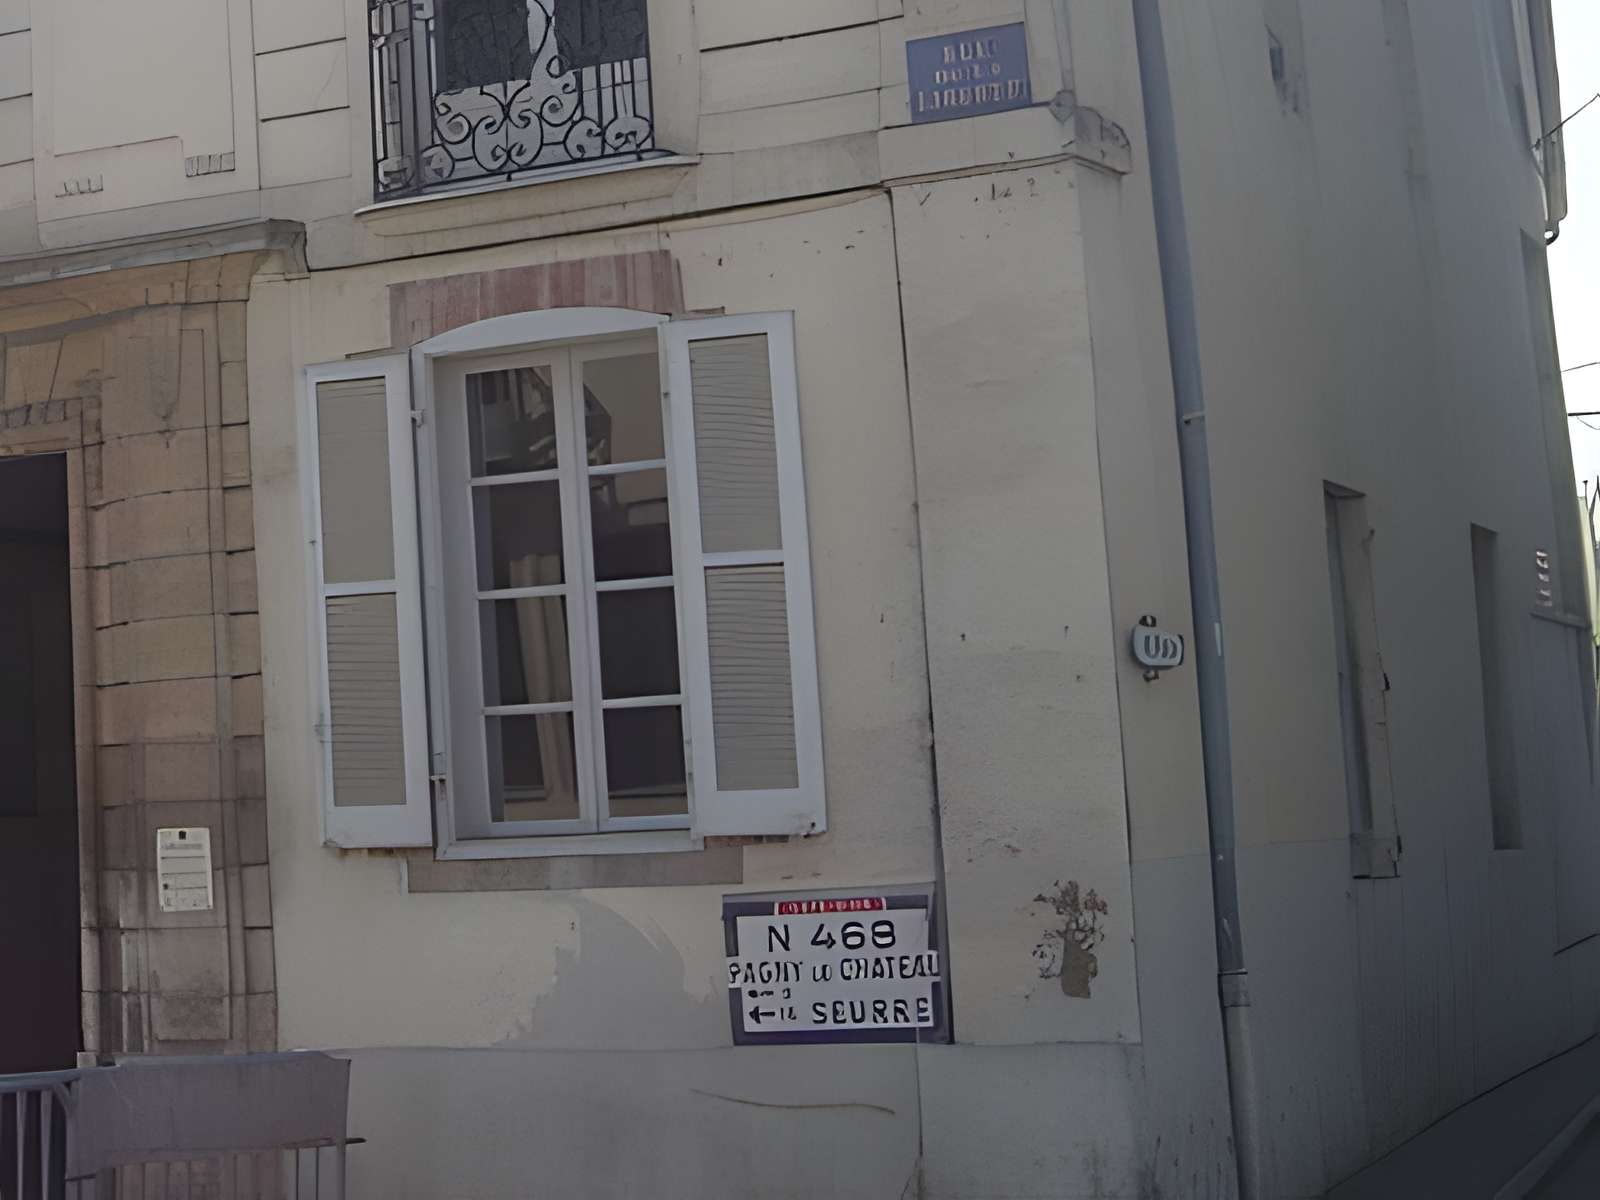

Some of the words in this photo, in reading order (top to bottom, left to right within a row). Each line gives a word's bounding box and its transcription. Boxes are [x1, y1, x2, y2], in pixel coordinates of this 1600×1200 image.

[767, 923, 791, 952] N
[810, 919, 896, 950] 468
[840, 954, 940, 982] CHATEAU
[812, 998, 930, 1024] SEURRE
